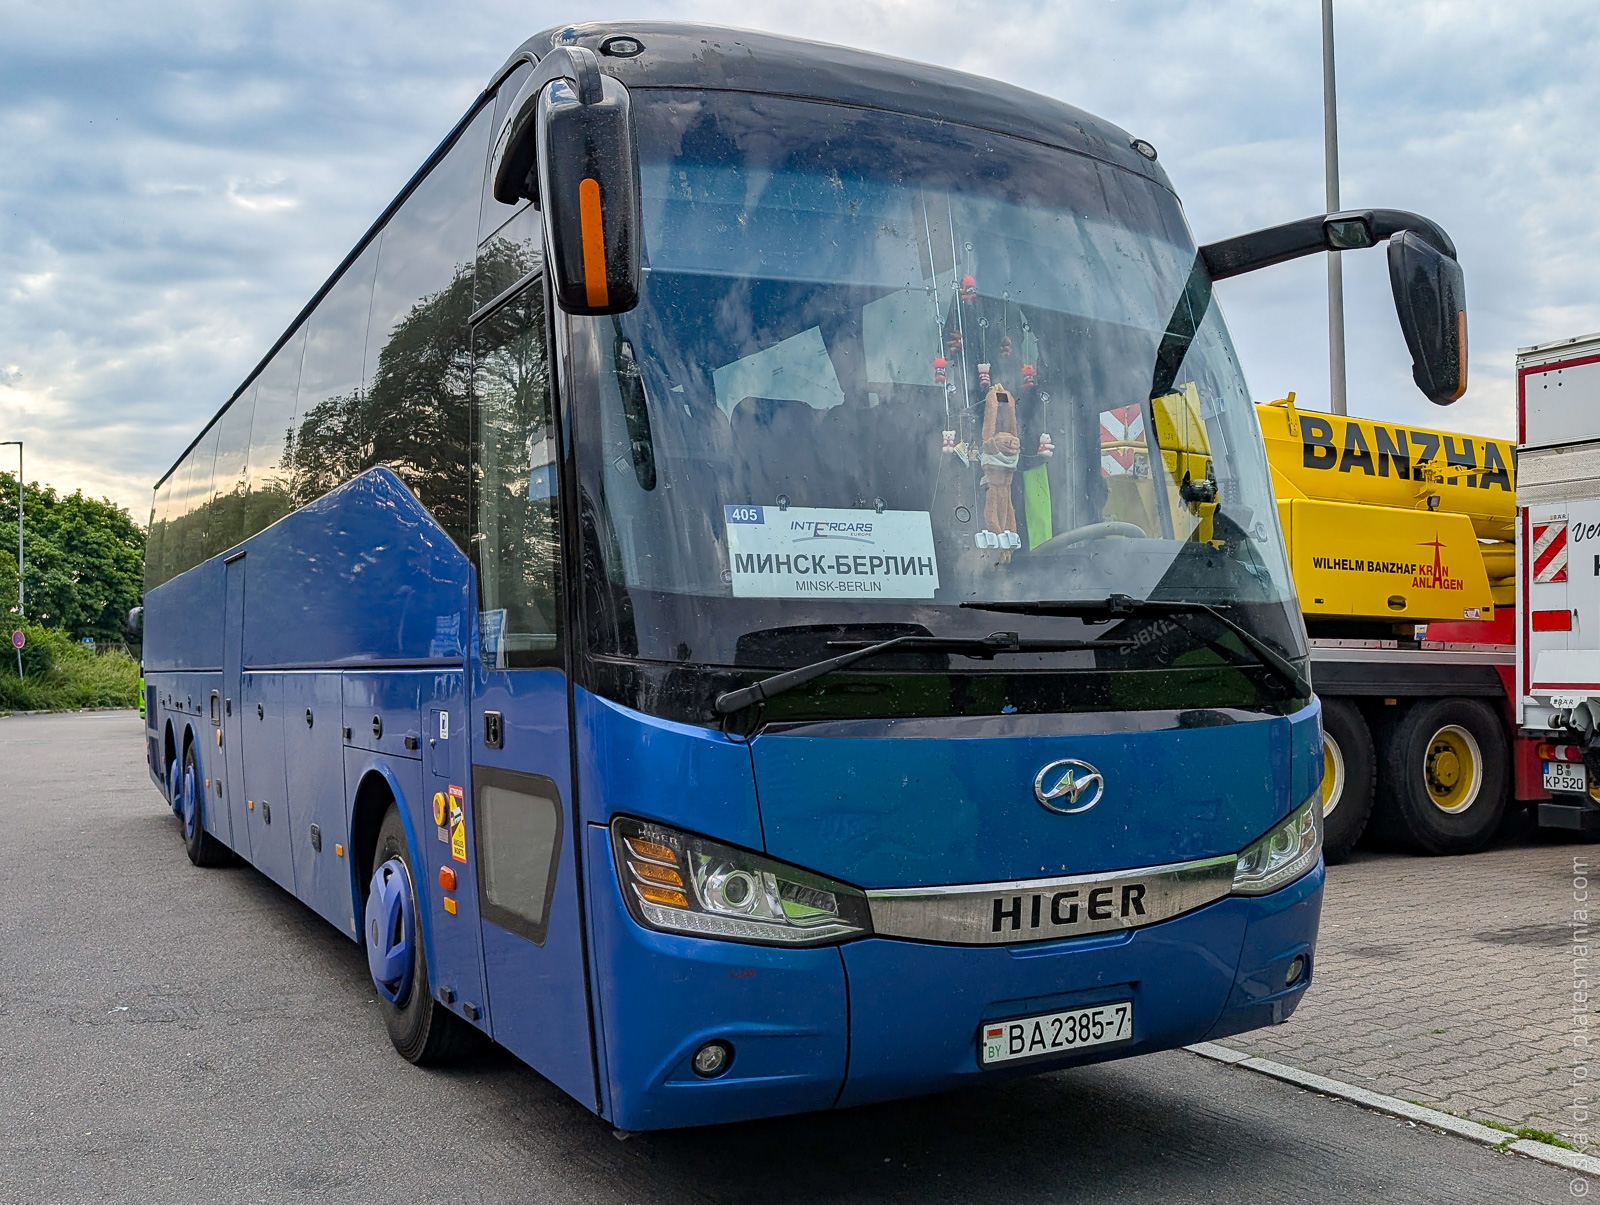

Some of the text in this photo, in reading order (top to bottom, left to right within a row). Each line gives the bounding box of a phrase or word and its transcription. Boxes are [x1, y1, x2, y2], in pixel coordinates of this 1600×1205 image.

[1299, 416, 1517, 493] BANZHA
[732, 508, 758, 521] 405
[790, 521, 873, 537] INTERCARS
[735, 553, 934, 576] МИНСК-БЕРЛИН
[1313, 557, 1449, 578] WILHELM BANZHAF KRAN
[796, 580, 882, 592] MINSK-BERLIN
[1412, 576, 1463, 590] ANLAGEN
[1556, 764, 1564, 775] B
[1545, 776, 1584, 790] KP 520
[991, 884, 1147, 932] HIGER
[988, 1045, 1002, 1058] BY
